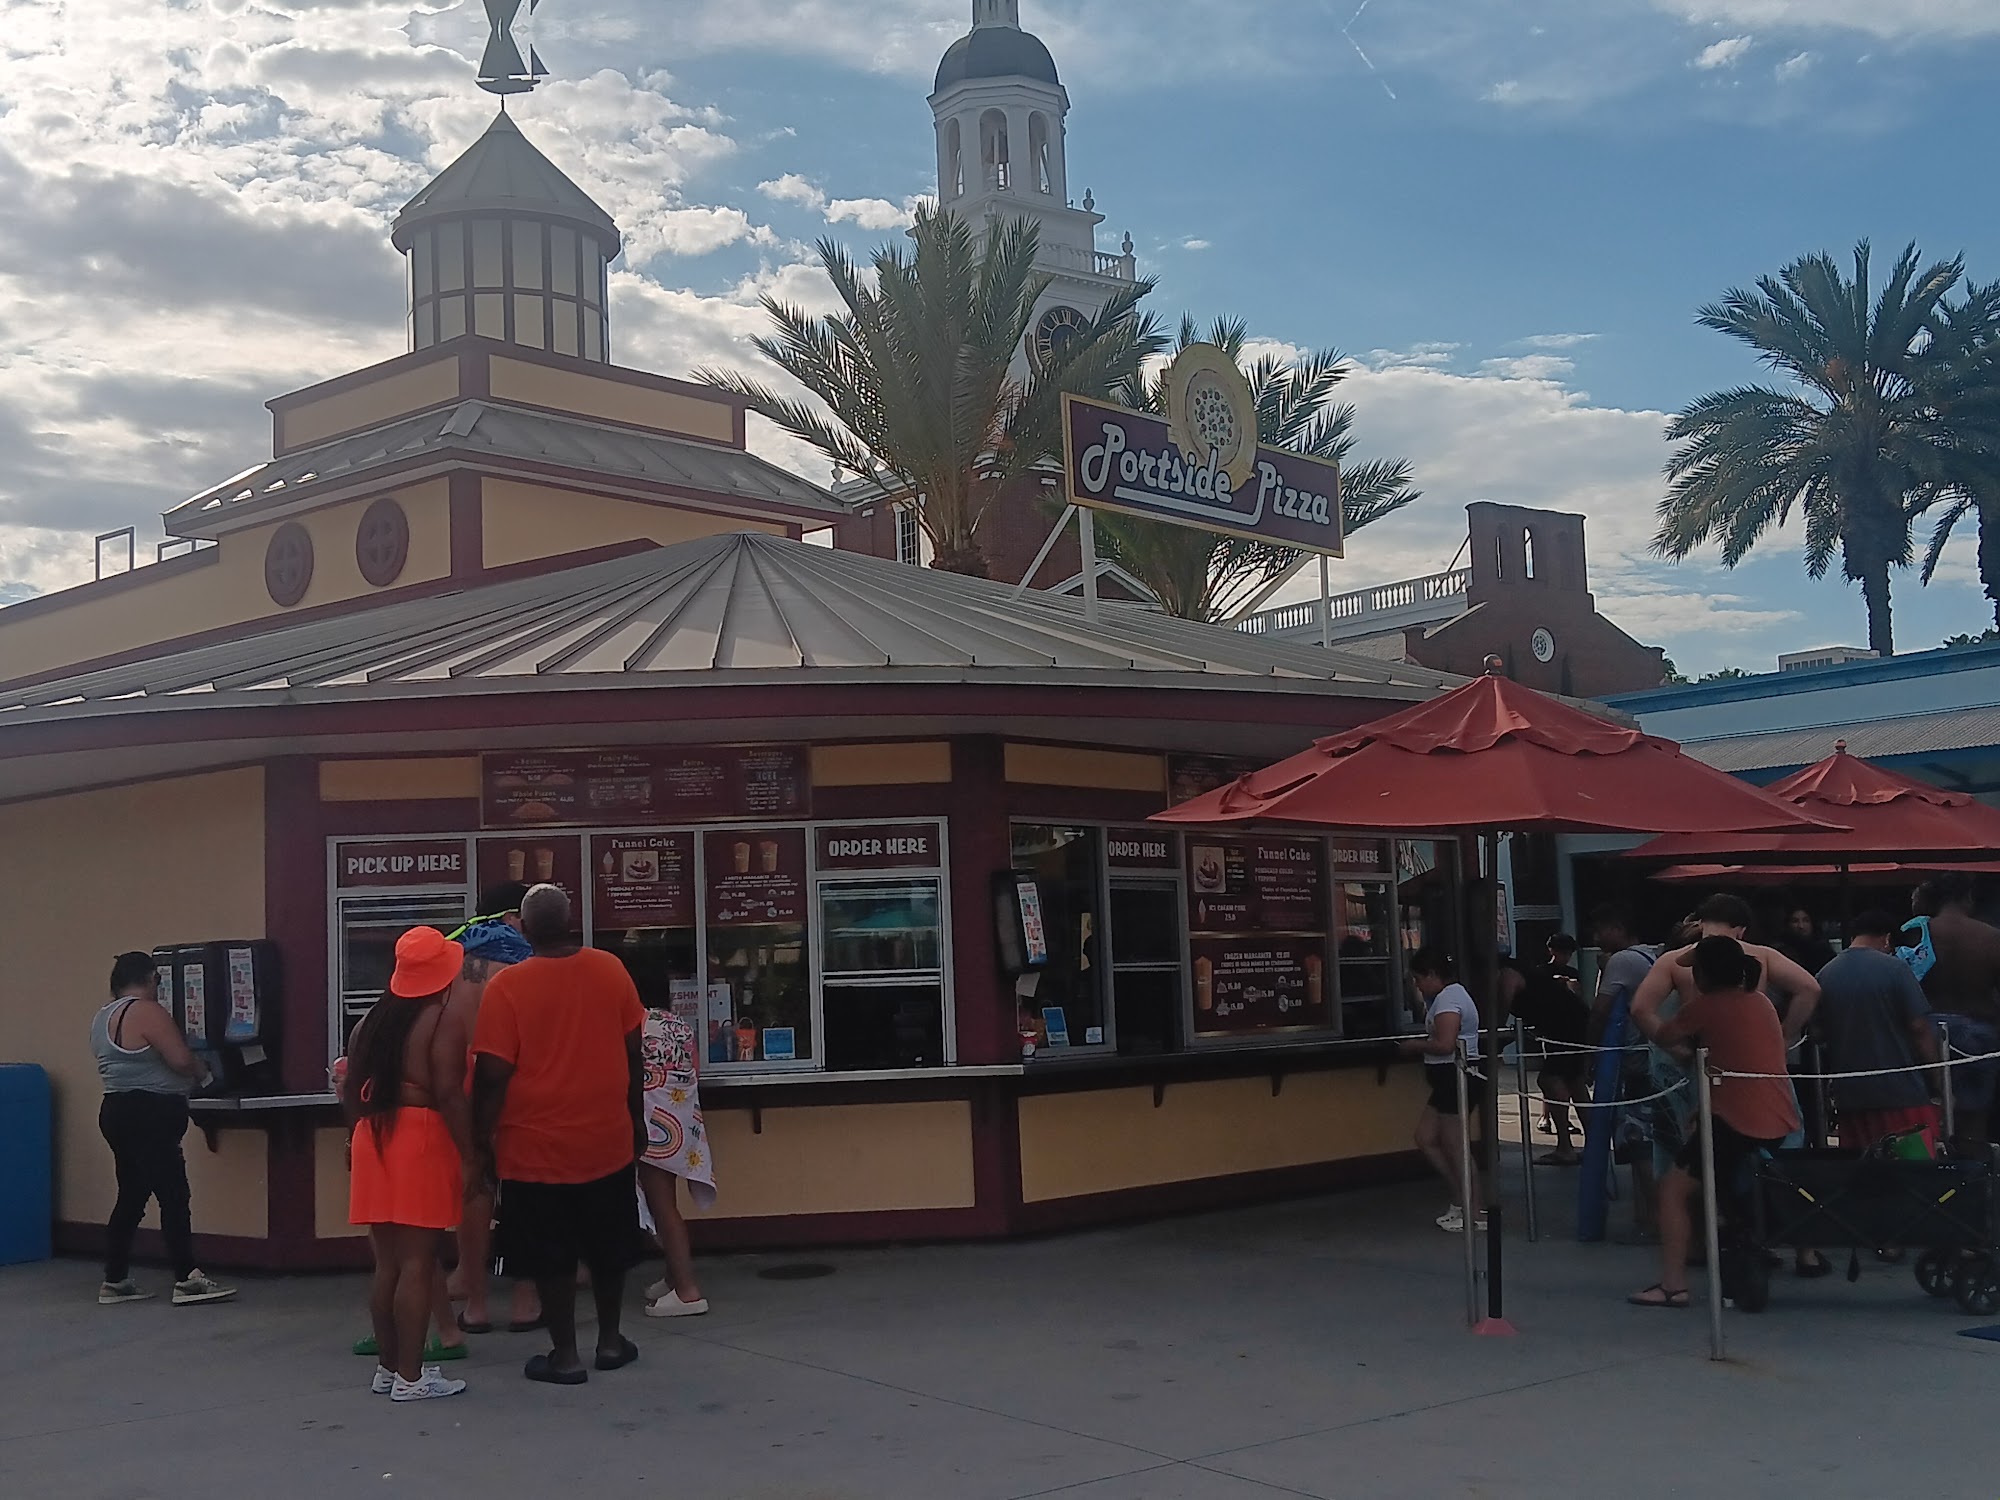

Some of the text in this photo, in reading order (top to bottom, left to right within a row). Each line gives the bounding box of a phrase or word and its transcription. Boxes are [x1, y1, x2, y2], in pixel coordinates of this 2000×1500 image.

[1081, 423, 1330, 525] Portside Pizza
[611, 838, 675, 849] Funnel Cake
[828, 838, 928, 857] ORDER HERE
[1108, 841, 1168, 858] ORDER HERE
[1258, 846, 1311, 861] Funnel Cake
[1360, 850, 1380, 864] HERE
[347, 854, 461, 875] PICK UP HERE
